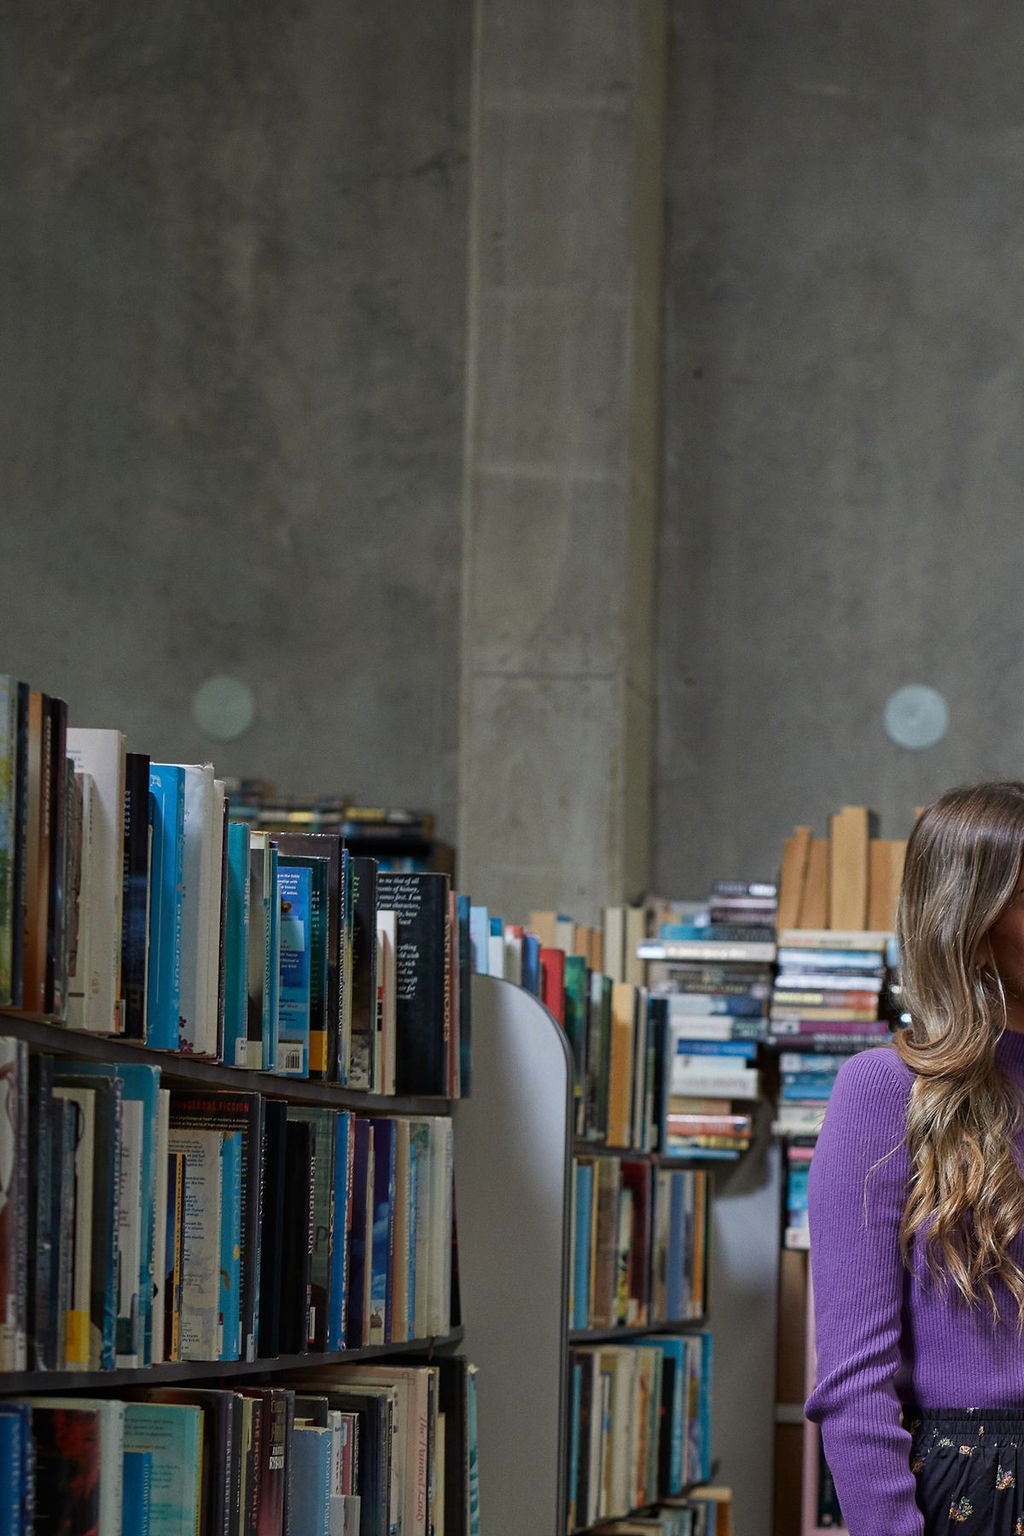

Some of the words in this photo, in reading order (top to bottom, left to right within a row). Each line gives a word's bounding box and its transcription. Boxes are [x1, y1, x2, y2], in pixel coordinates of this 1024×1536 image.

[218, 1101, 250, 1112] FICTION
[308, 1156, 316, 1256] RETRIBUTION
[419, 1414, 427, 1438] The
[418, 1440, 427, 1488] Painted
[416, 1489, 426, 1525] Lady
